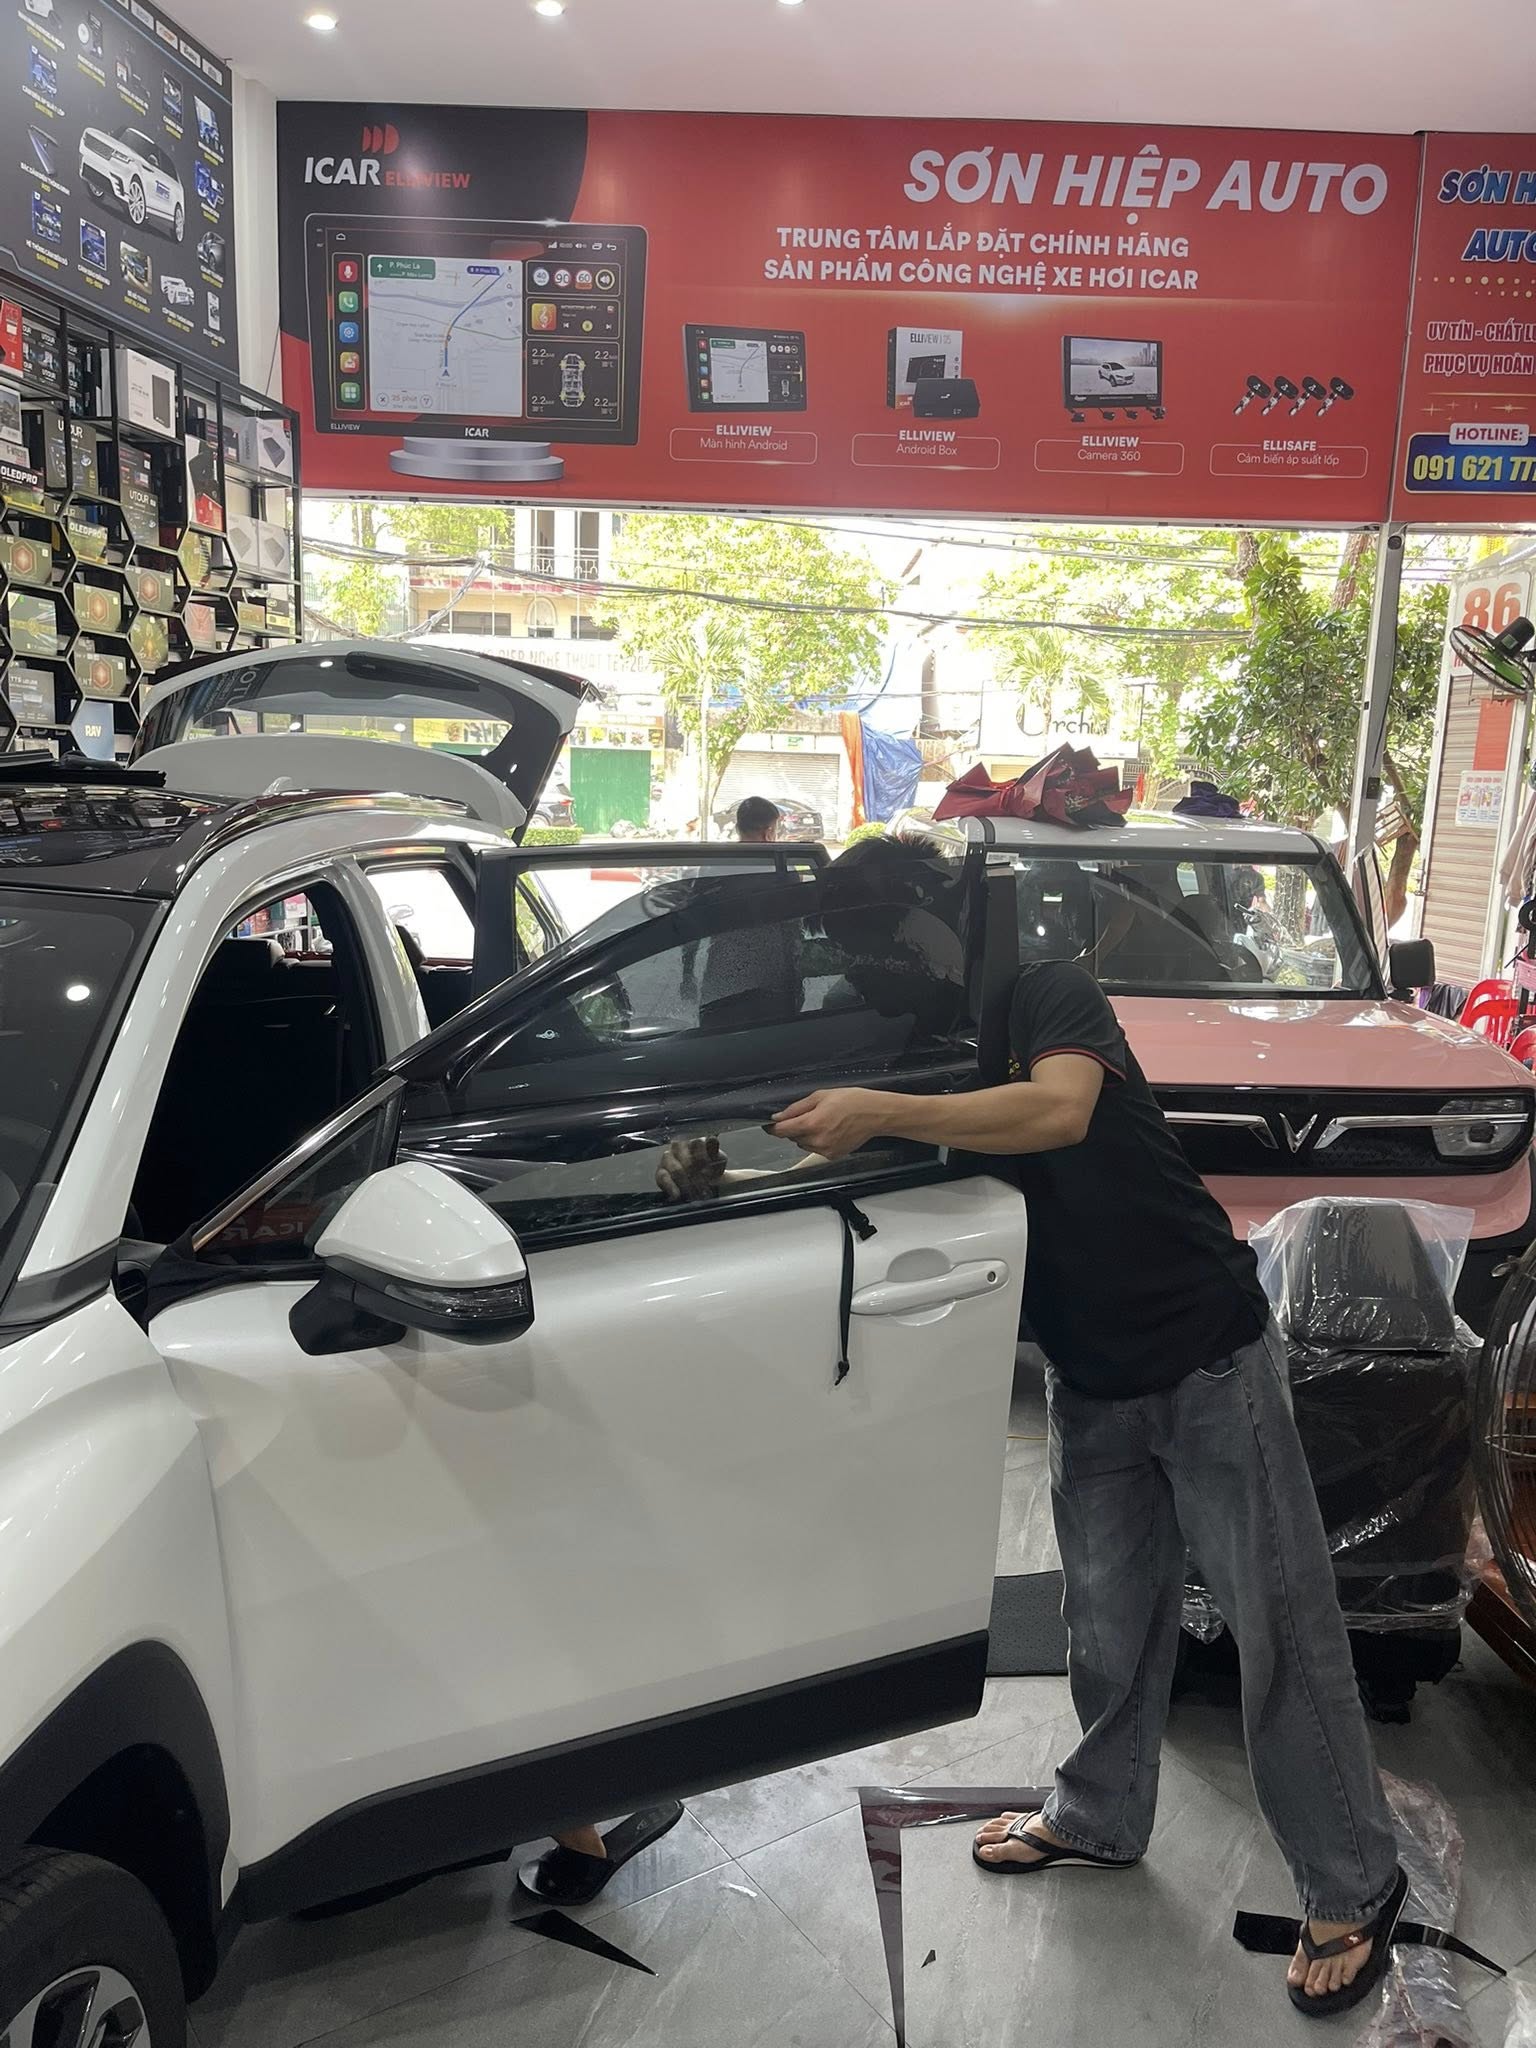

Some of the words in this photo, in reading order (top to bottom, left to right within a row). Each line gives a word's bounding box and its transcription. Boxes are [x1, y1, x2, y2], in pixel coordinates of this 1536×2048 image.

[304, 157, 381, 186] ICAR
[384, 171, 471, 189] ELLIVIEW
[903, 146, 1044, 205] SƠN
[1054, 145, 1200, 225] HIỆP
[1207, 161, 1388, 216] AUTO
[1438, 165, 1512, 204] SƠN
[776, 227, 861, 249] TRUNG
[865, 225, 919, 250] TÂM
[926, 222, 971, 251] LẮP
[977, 228, 1025, 259] ĐẶT
[1029, 229, 1110, 256] CHÍNH
[1117, 231, 1189, 258] HÃNG
[764, 253, 814, 280] SẢN
[820, 253, 892, 282] PHẨM
[899, 258, 972, 284] CÔNG
[978, 261, 1047, 292] NGHỆ
[1052, 266, 1083, 287] XE
[1089, 266, 1133, 288] HƠI
[1140, 269, 1199, 290] ICAR
[1427, 322, 1447, 341] UY
[1449, 319, 1473, 341] TÍN
[1485, 317, 1523, 342] CHẤT
[1424, 353, 1466, 377] PHỤC
[1468, 354, 1489, 378] VỤ
[1491, 352, 1534, 375] HOÀN
[330, 423, 361, 432] ELLIVIEW
[464, 427, 489, 438] ICAR
[715, 424, 773, 437] ELLIVIEW
[1455, 427, 1523, 442] HOTLINE:
[899, 430, 956, 442] ELLIVIEW
[1081, 435, 1140, 448] ELLIVIEW
[700, 438, 723, 449] Màn
[748, 438, 788, 451] Android
[896, 443, 936, 456] Android
[938, 444, 958, 456] Box
[1263, 440, 1317, 452] ELLISAFE
[1077, 449, 1118, 461] Camera
[1120, 450, 1141, 462] 360
[1236, 451, 1260, 464] Cảm
[1263, 452, 1284, 464] biến
[1286, 454, 1299, 467] áp
[1301, 453, 1321, 465] suất
[1323, 453, 1340, 467] lốp
[0, 465, 38, 485] OLEDPRO
[1413, 455, 1455, 480] 091
[1462, 455, 1503, 481] 621
